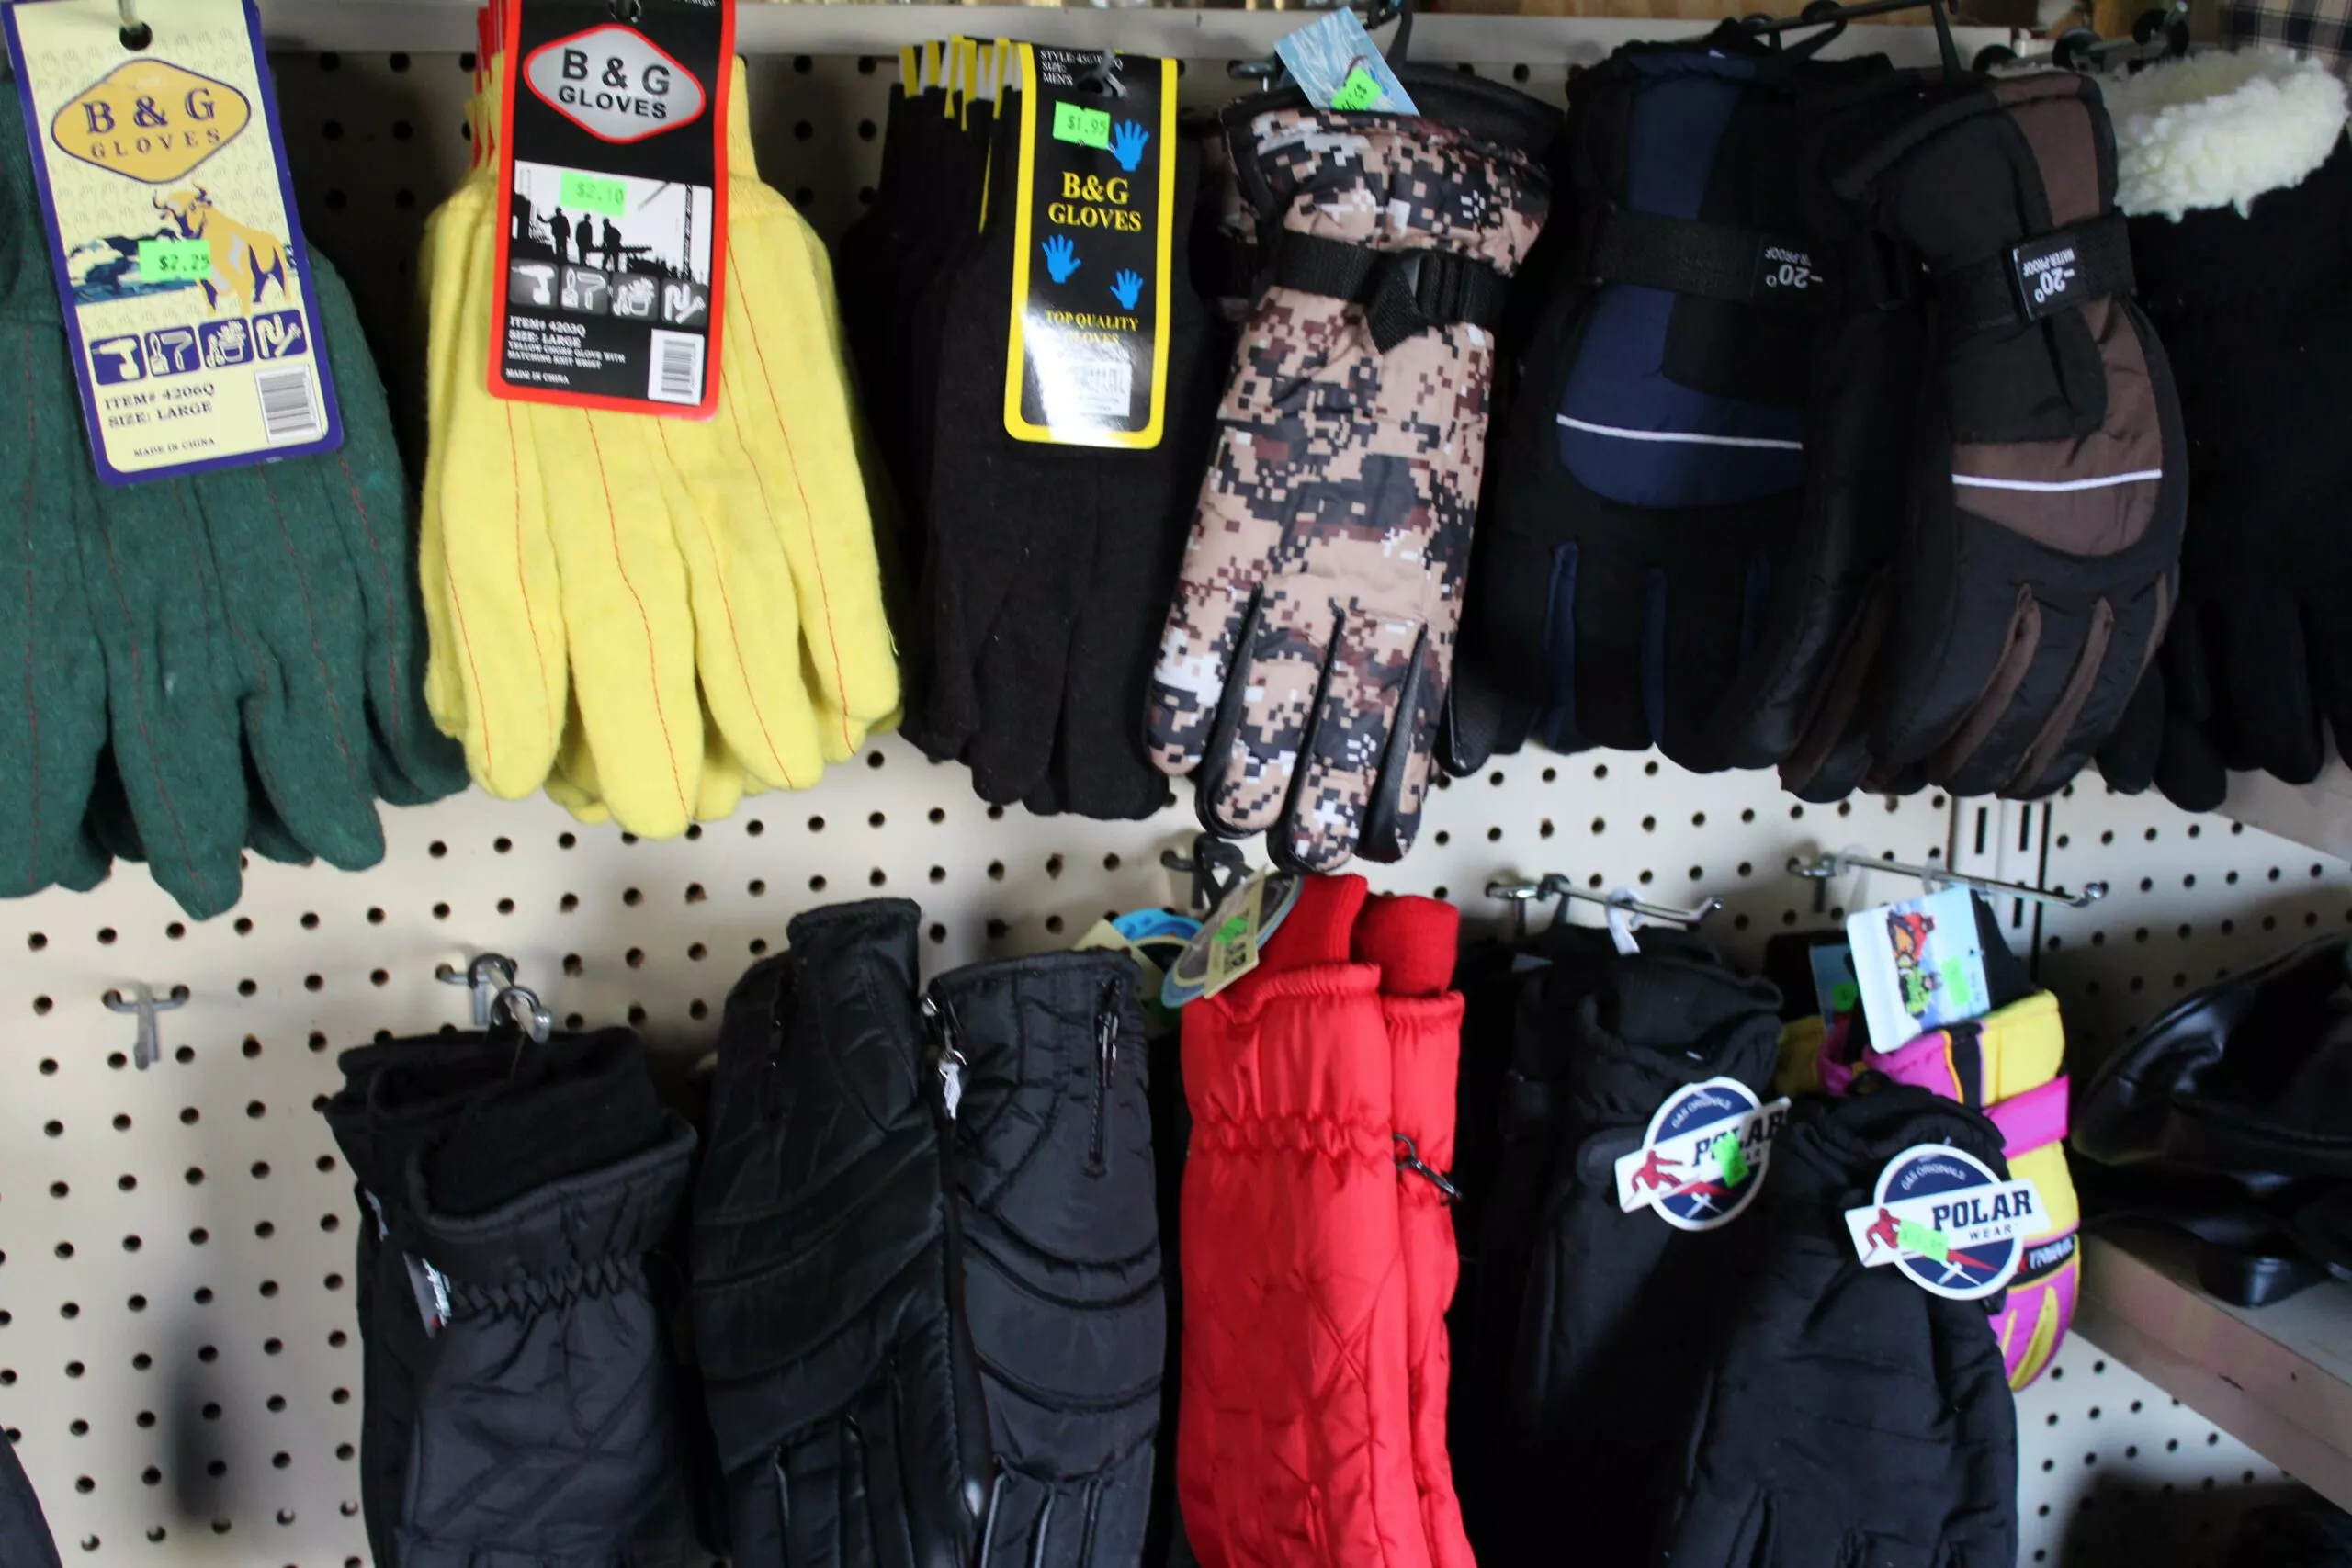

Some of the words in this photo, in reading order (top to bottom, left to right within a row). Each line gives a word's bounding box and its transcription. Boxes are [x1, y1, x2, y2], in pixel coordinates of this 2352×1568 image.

[562, 48, 588, 80] B
[602, 56, 628, 89] &
[641, 63, 671, 95] G
[83, 100, 115, 134] B
[133, 95, 168, 127] &
[185, 87, 215, 120] G
[558, 85, 667, 119] GLOVES
[90, 128, 220, 159] GLOVES
[576, 182, 624, 204] $2.10
[1061, 171, 1129, 205] B&G
[1047, 201, 1142, 232] GLOVES
[159, 254, 209, 272] $2.25
[1046, 310, 1073, 325] TOP
[1075, 312, 1139, 331] QUALITY
[541, 333, 582, 349] LARGE
[1065, 331, 1122, 345] LOVES
[603, 352, 626, 364] WITH
[505, 367, 531, 380] MADE
[531, 370, 542, 381] IN
[542, 372, 570, 385] CHINA
[156, 400, 212, 420] LARGE
[133, 445, 164, 457] MADE
[167, 443, 178, 453] IN
[181, 437, 216, 450] CHINA
[1691, 1110, 1786, 1168] PAR
[1932, 1190, 2032, 1231] POLAR
[1968, 1225, 2012, 1241] WEAR
